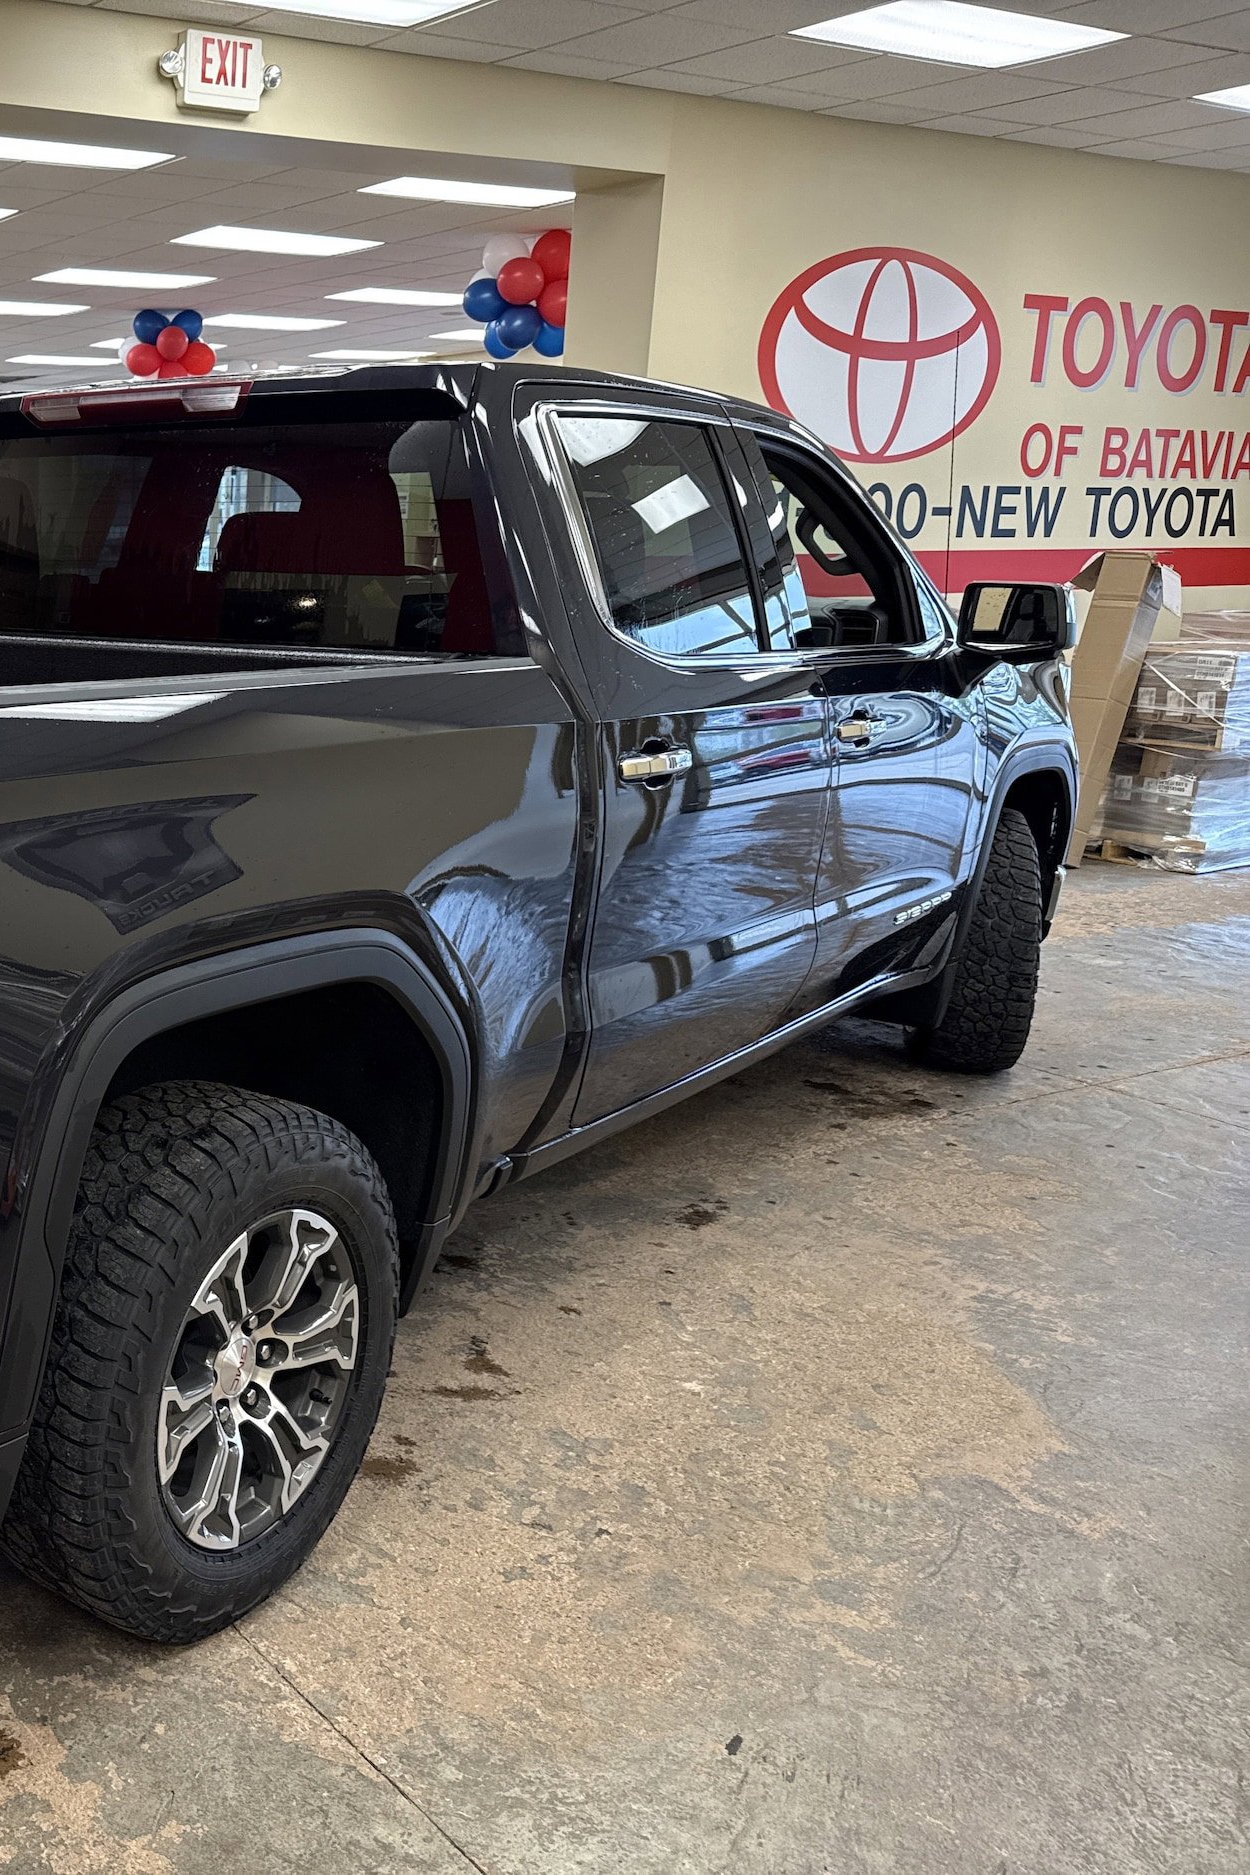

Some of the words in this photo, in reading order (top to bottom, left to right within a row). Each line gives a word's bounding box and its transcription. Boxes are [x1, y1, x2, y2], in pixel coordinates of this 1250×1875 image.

[201, 36, 253, 88] EXIT
[1020, 422, 1084, 479] OF
[1099, 426, 1250, 481] BATAVIA
[1085, 485, 1236, 539] TOYOTA
[894, 891, 952, 925] SIERRA
[230, 1344, 248, 1391] GMC
